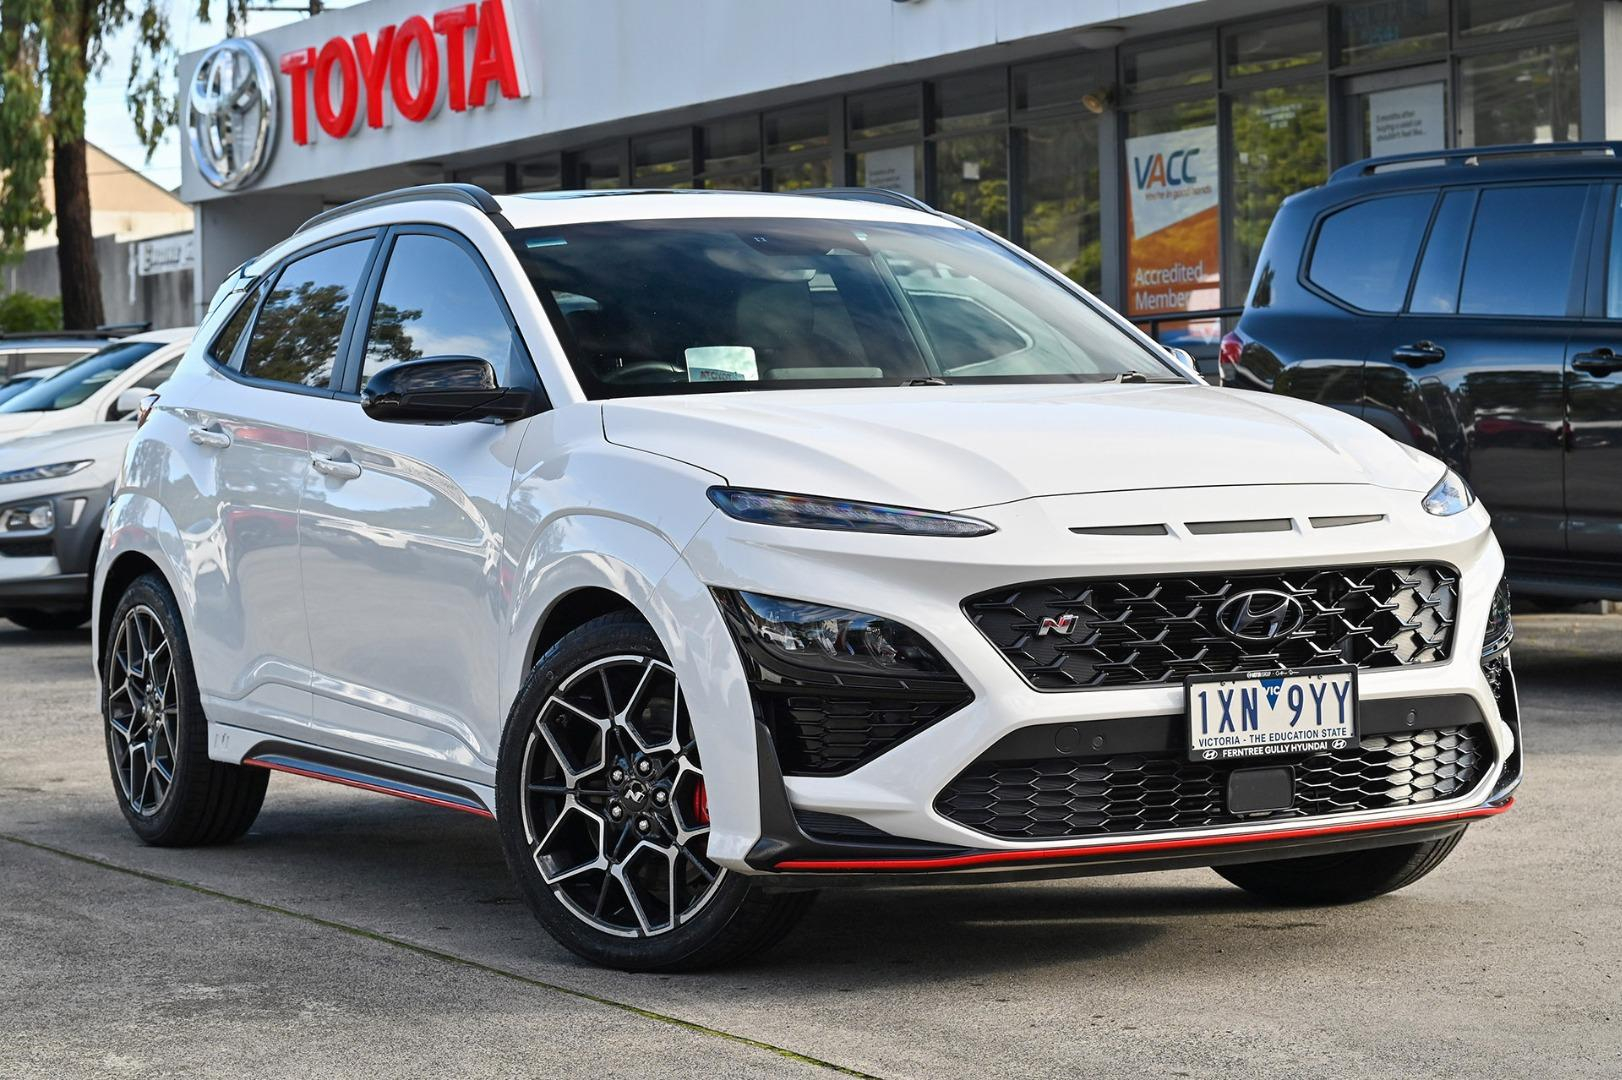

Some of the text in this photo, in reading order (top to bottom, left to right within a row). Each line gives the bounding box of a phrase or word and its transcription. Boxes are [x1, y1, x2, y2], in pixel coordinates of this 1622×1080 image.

[280, 0, 521, 146] TOYOTA
[1134, 148, 1200, 190] VACC
[1135, 260, 1203, 286] Accredited
[1135, 288, 1191, 310] Member
[1265, 685, 1281, 695] VIC
[1198, 681, 1350, 734] 1XN 9YY
[1199, 736, 1240, 748] VICTORIA
[1250, 732, 1266, 744] THE
[1269, 729, 1319, 741] EDUCATION
[1322, 726, 1347, 737] STATE
[1222, 741, 1328, 758] FERNTREE GULLY HYUNDAI
